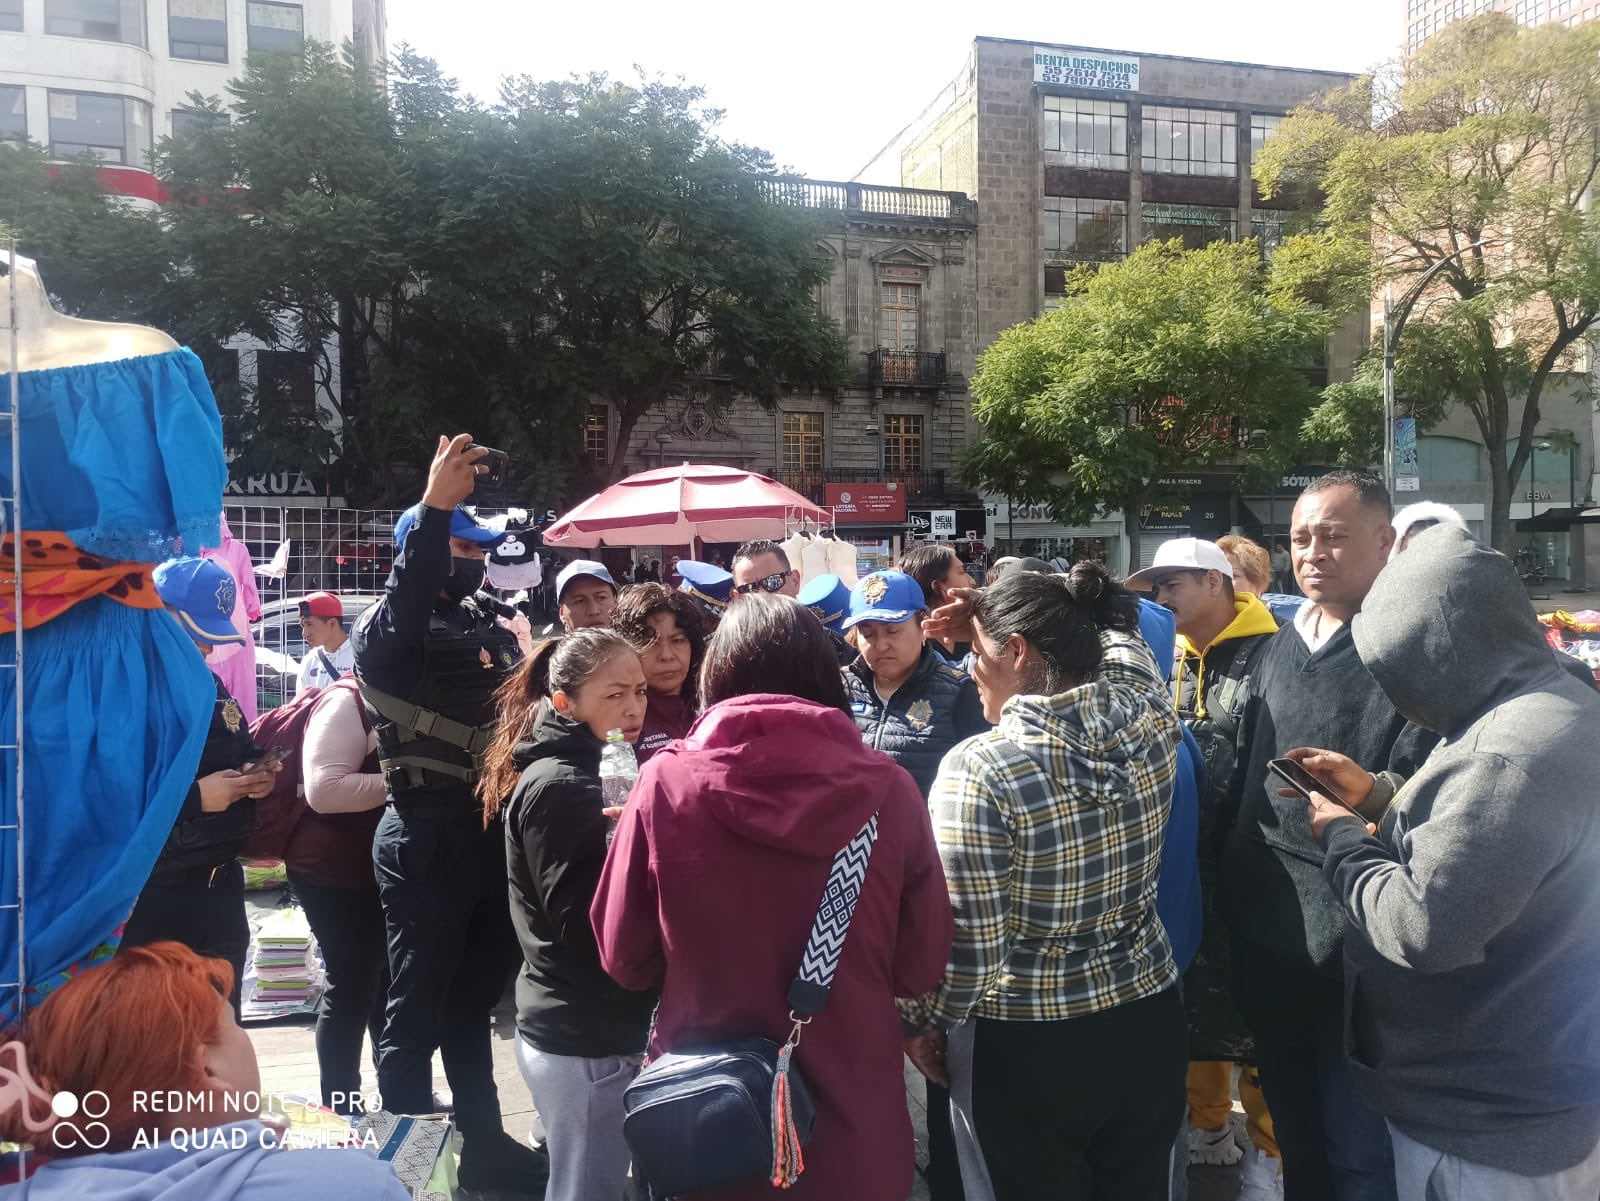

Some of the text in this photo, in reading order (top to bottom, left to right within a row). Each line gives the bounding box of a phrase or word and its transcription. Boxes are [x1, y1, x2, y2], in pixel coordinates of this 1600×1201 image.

[1035, 53, 1138, 74] RENTA DESPACHOS
[1042, 73, 1131, 90] 55 7907 0525
[1044, 65, 1129, 82] 55 2614 7514
[935, 515, 952, 523] NEW
